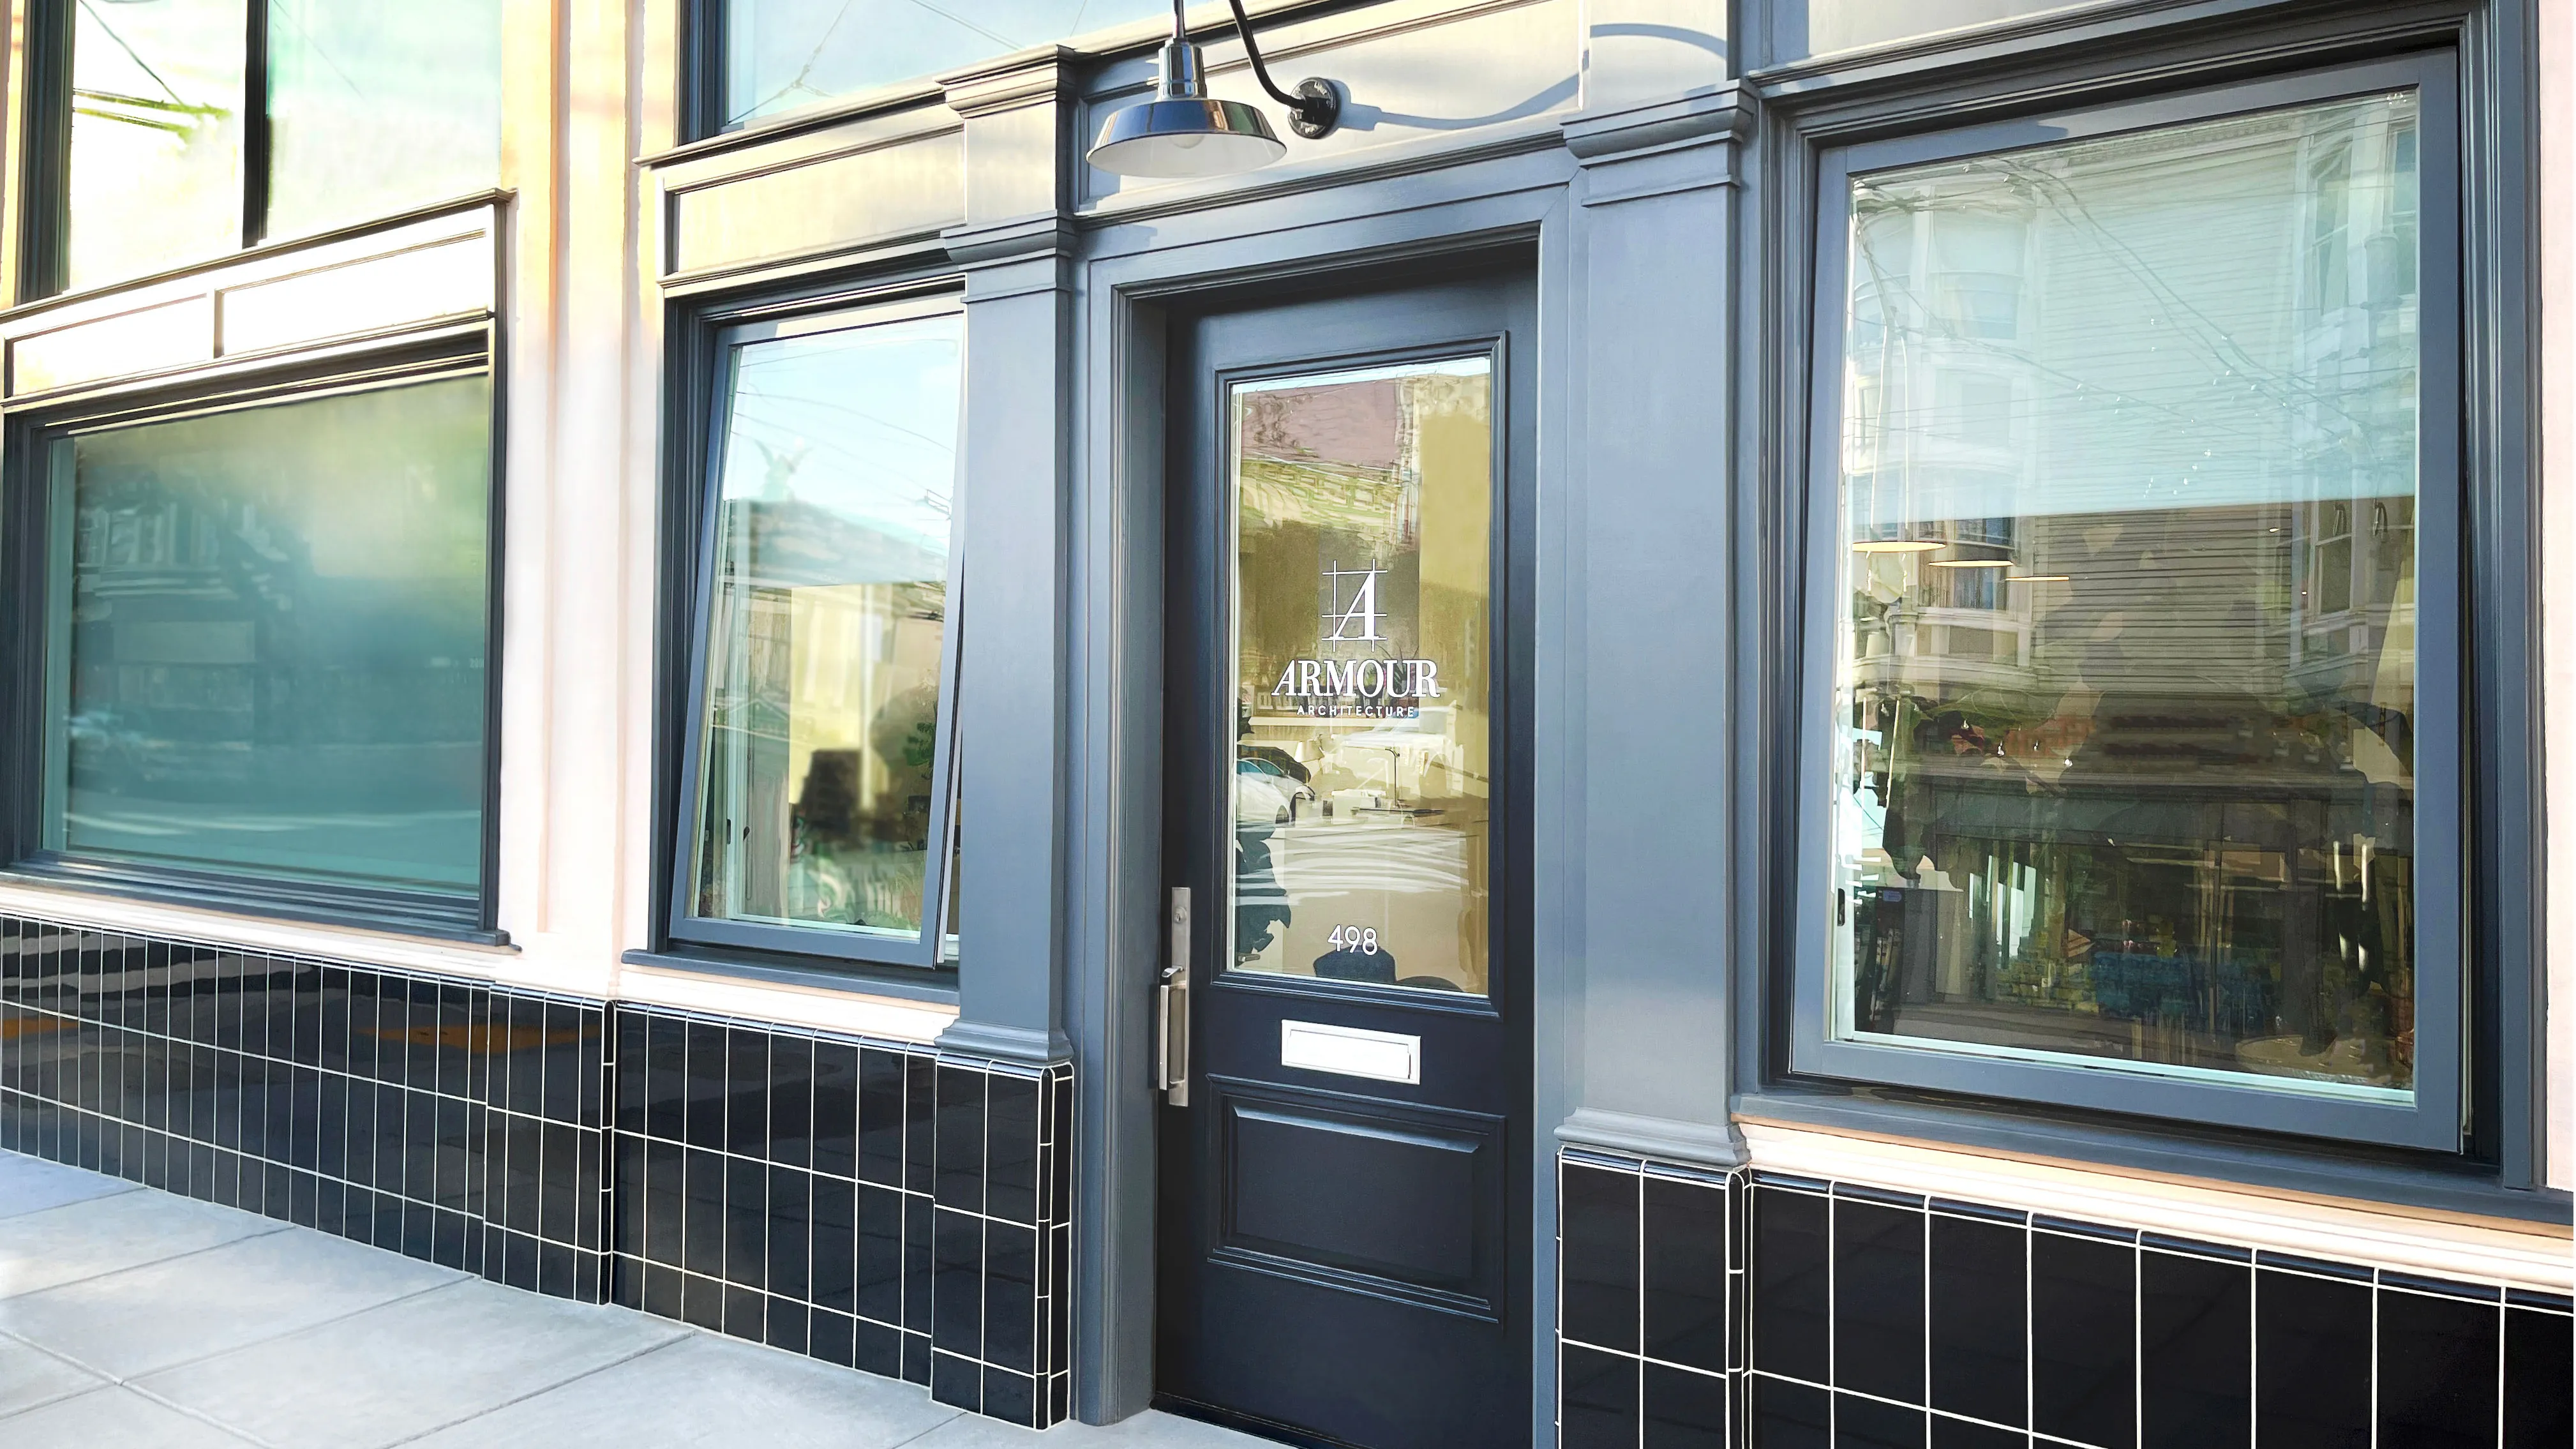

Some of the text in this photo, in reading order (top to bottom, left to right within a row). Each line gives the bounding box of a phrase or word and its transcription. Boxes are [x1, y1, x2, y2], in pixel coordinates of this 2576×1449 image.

[1328, 569, 1381, 641] A
[1271, 659, 1441, 698] ARMOUR
[1296, 705, 1415, 718] ARCHITECTURE
[1327, 924, 1378, 956] 498
